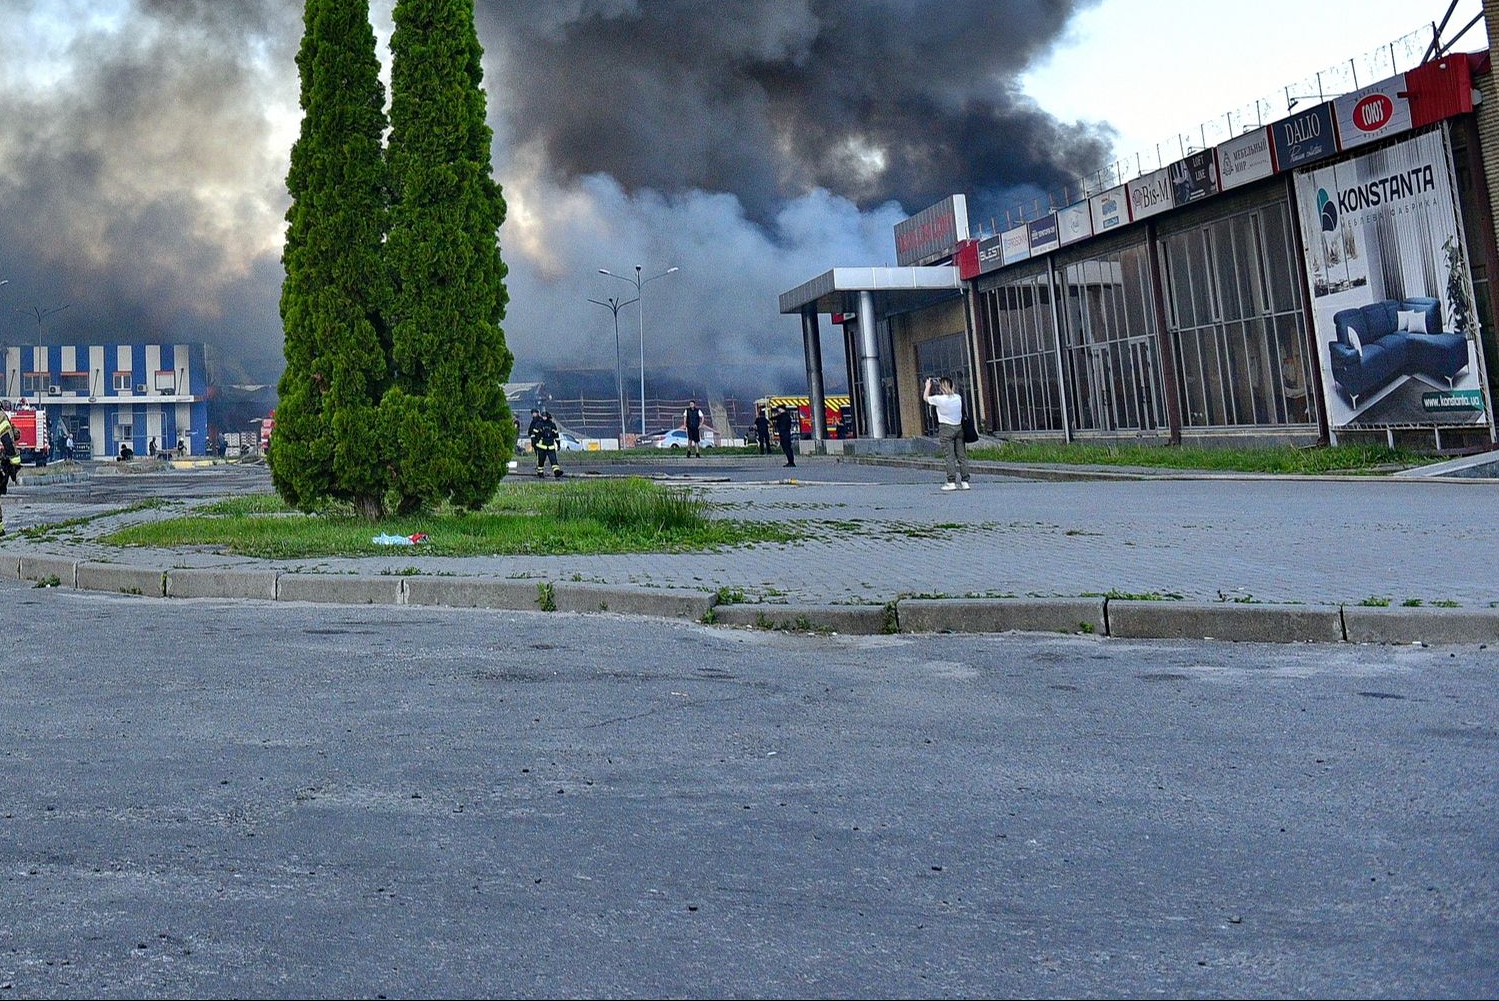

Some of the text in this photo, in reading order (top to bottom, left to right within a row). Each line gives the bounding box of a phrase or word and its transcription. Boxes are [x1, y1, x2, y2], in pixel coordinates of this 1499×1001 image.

[1284, 112, 1321, 147] DALIO
[1234, 161, 1247, 173] МИР
[1141, 177, 1170, 208] Bis-M
[1337, 164, 1435, 215] KONSTANTA
[1390, 198, 1438, 217] ФАБРИКА
[1423, 394, 1480, 407] www.konstanta.ua
